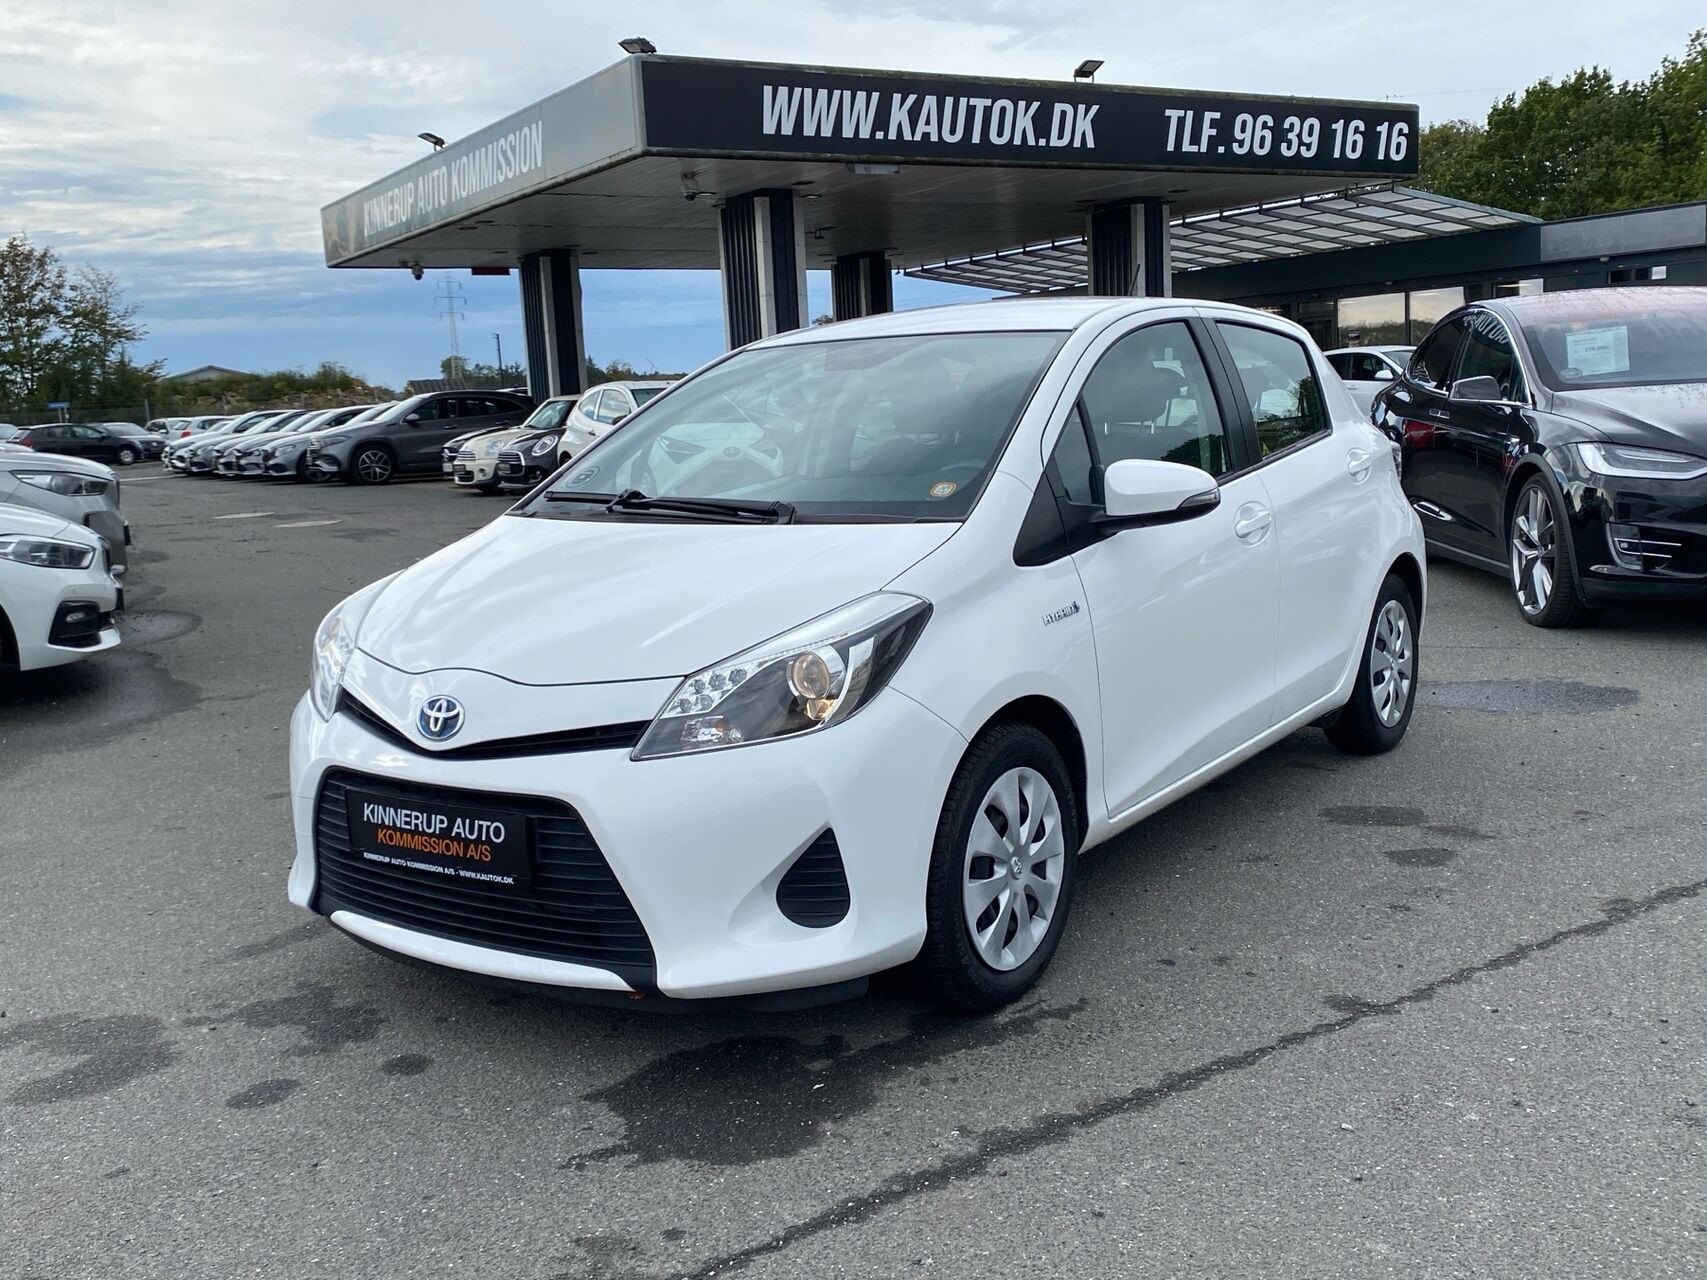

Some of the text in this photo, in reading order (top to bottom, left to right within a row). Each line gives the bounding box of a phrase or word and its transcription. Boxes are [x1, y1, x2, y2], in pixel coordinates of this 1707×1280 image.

[762, 84, 1100, 149] WWW.KAUTOK.DK
[1164, 108, 1410, 162] TLF. 96 39 16 16
[363, 120, 543, 237] KINNERUP AUTO KOMMISSION
[363, 802, 506, 844] KINNERUP AUTO
[377, 828, 492, 862] KOMMISSION A/S
[391, 857, 406, 867] AUTO
